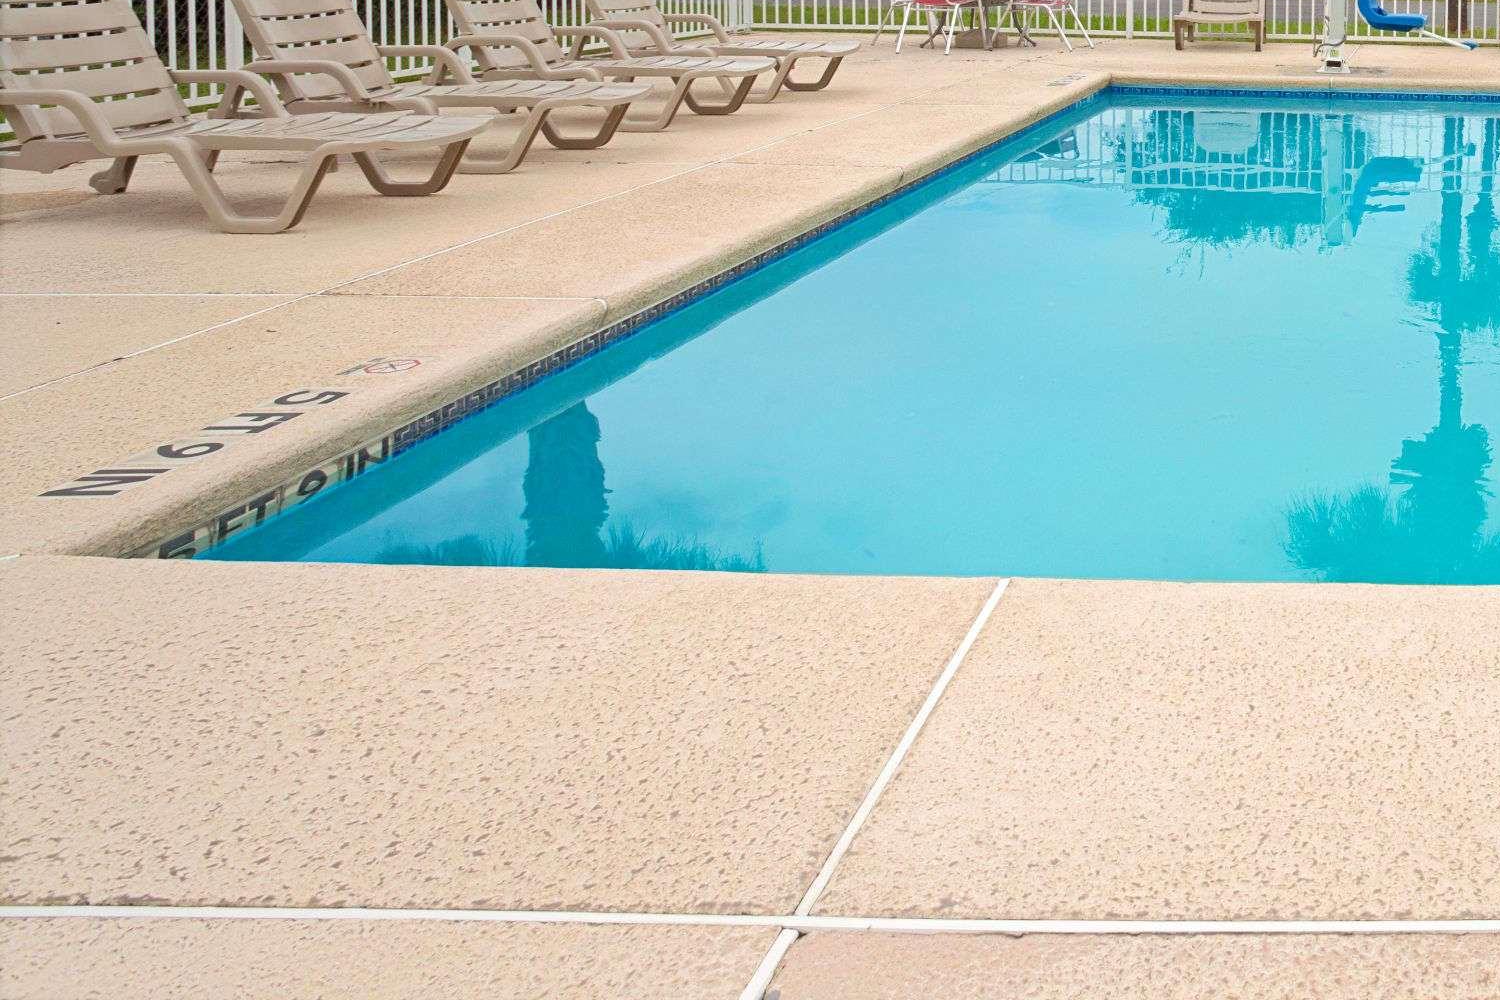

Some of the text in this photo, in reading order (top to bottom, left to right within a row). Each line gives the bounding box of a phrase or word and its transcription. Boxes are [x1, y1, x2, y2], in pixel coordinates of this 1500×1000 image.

[274, 389, 350, 405] 5
[202, 411, 304, 434] FT
[37, 467, 172, 497] IN
[216, 489, 278, 541] FT
[296, 469, 328, 503] 9
[345, 435, 391, 481] IN
